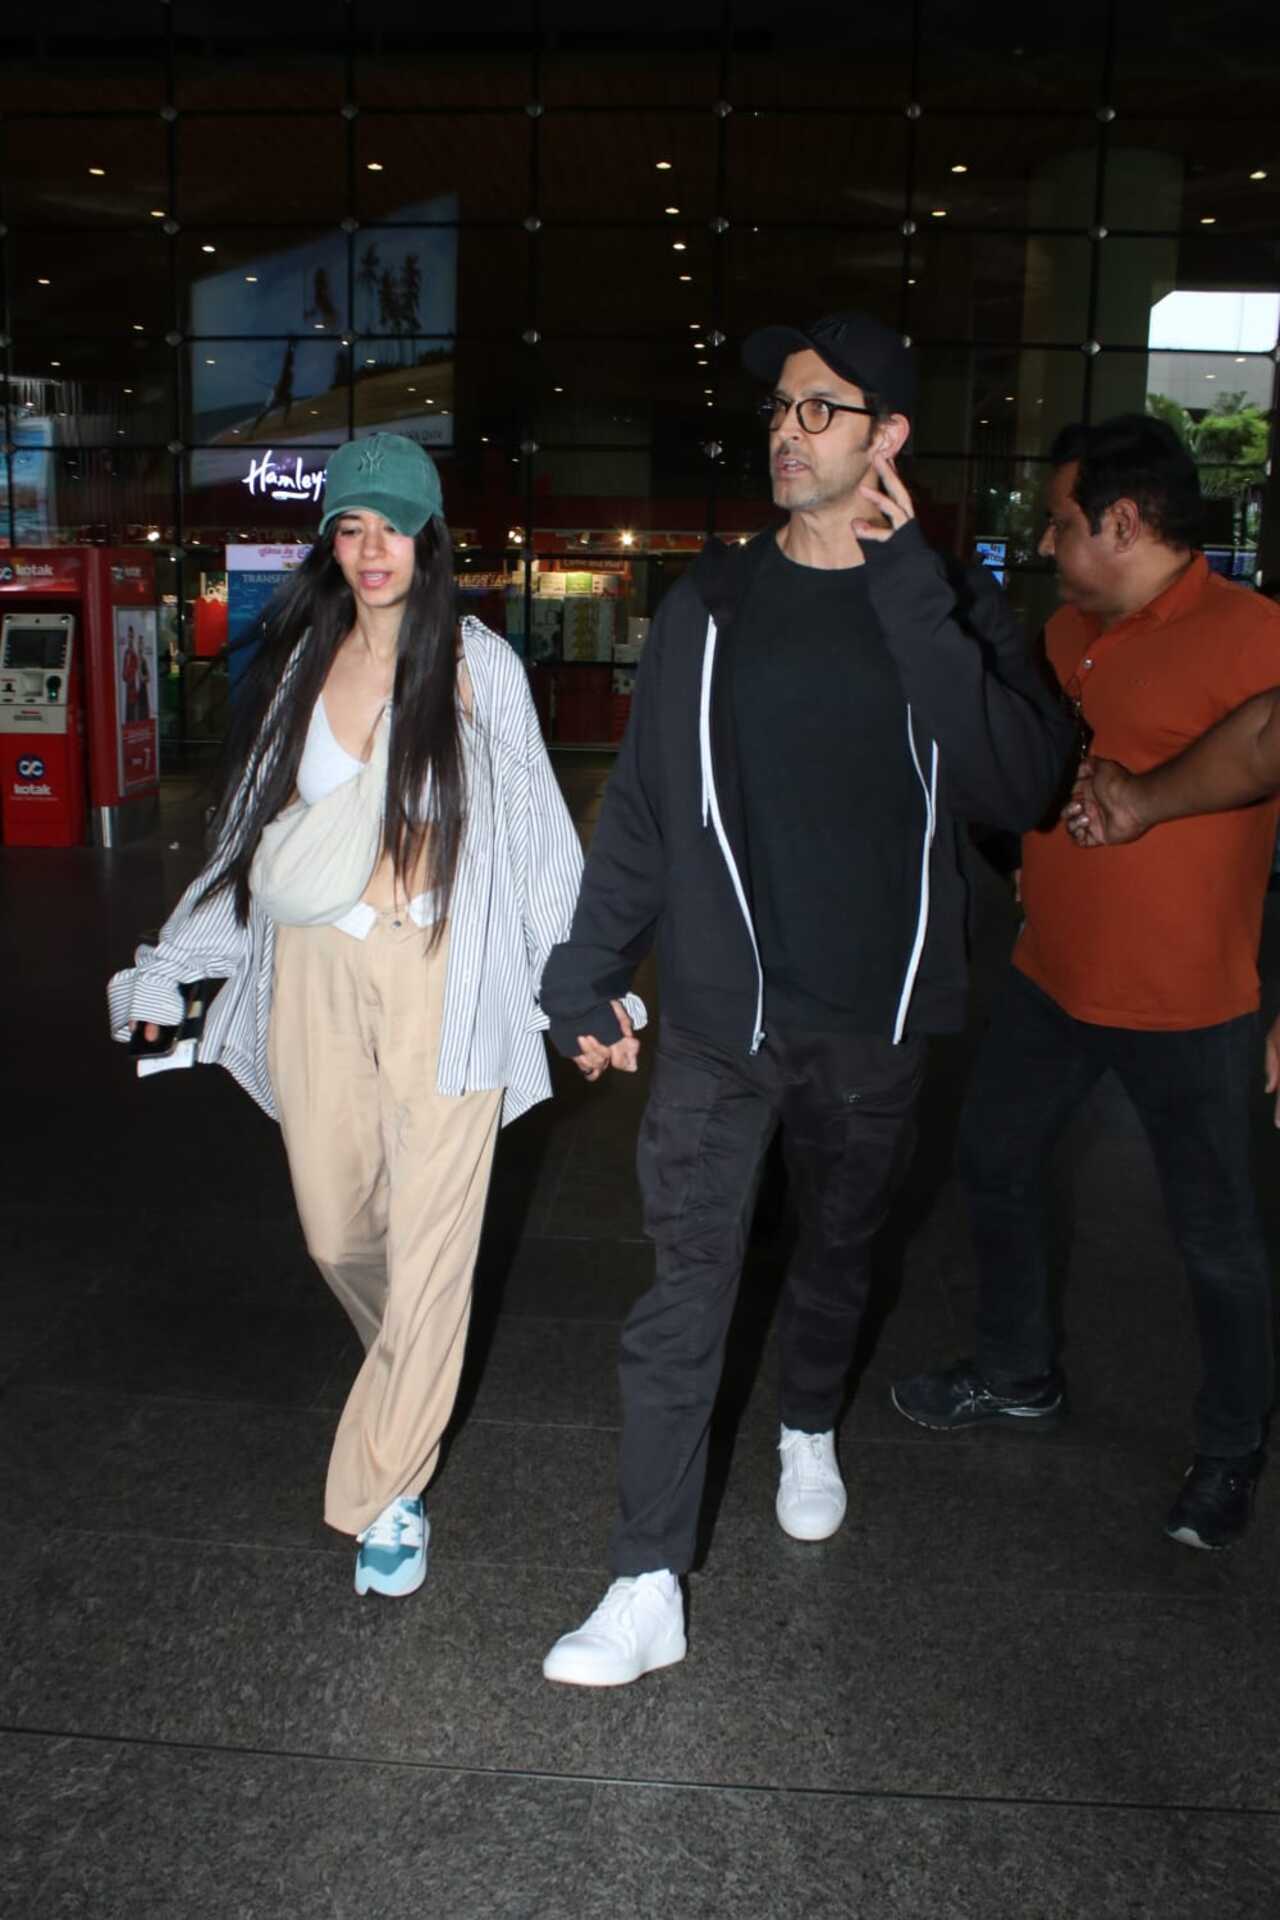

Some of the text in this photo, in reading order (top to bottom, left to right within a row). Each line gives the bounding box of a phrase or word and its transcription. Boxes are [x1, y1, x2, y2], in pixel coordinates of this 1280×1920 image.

[242, 450, 327, 501] Hamley
[16, 564, 54, 576] kotak
[13, 783, 52, 795] kotak
